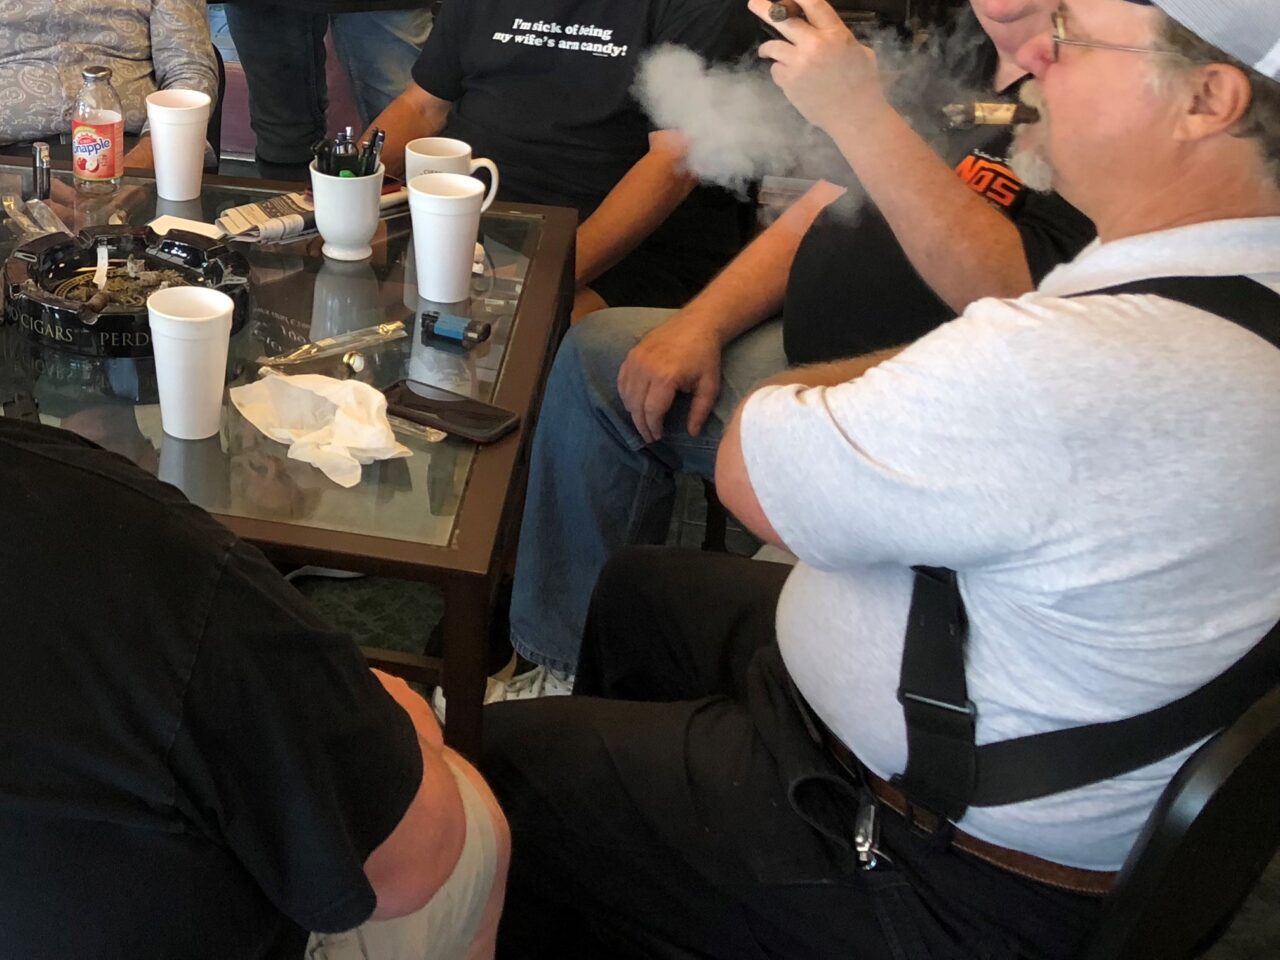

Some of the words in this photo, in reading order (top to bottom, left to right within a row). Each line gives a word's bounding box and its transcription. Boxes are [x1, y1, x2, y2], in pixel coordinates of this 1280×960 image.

[512, 18, 532, 30] I'm
[532, 20, 562, 34] sick
[565, 24, 578, 35] of
[578, 25, 613, 40] being
[492, 31, 514, 43] my
[514, 34, 555, 48] wife's
[558, 41, 579, 50] arm
[581, 42, 628, 57] candy!
[21, 313, 73, 342] CIGARS
[100, 332, 150, 346] PERD
